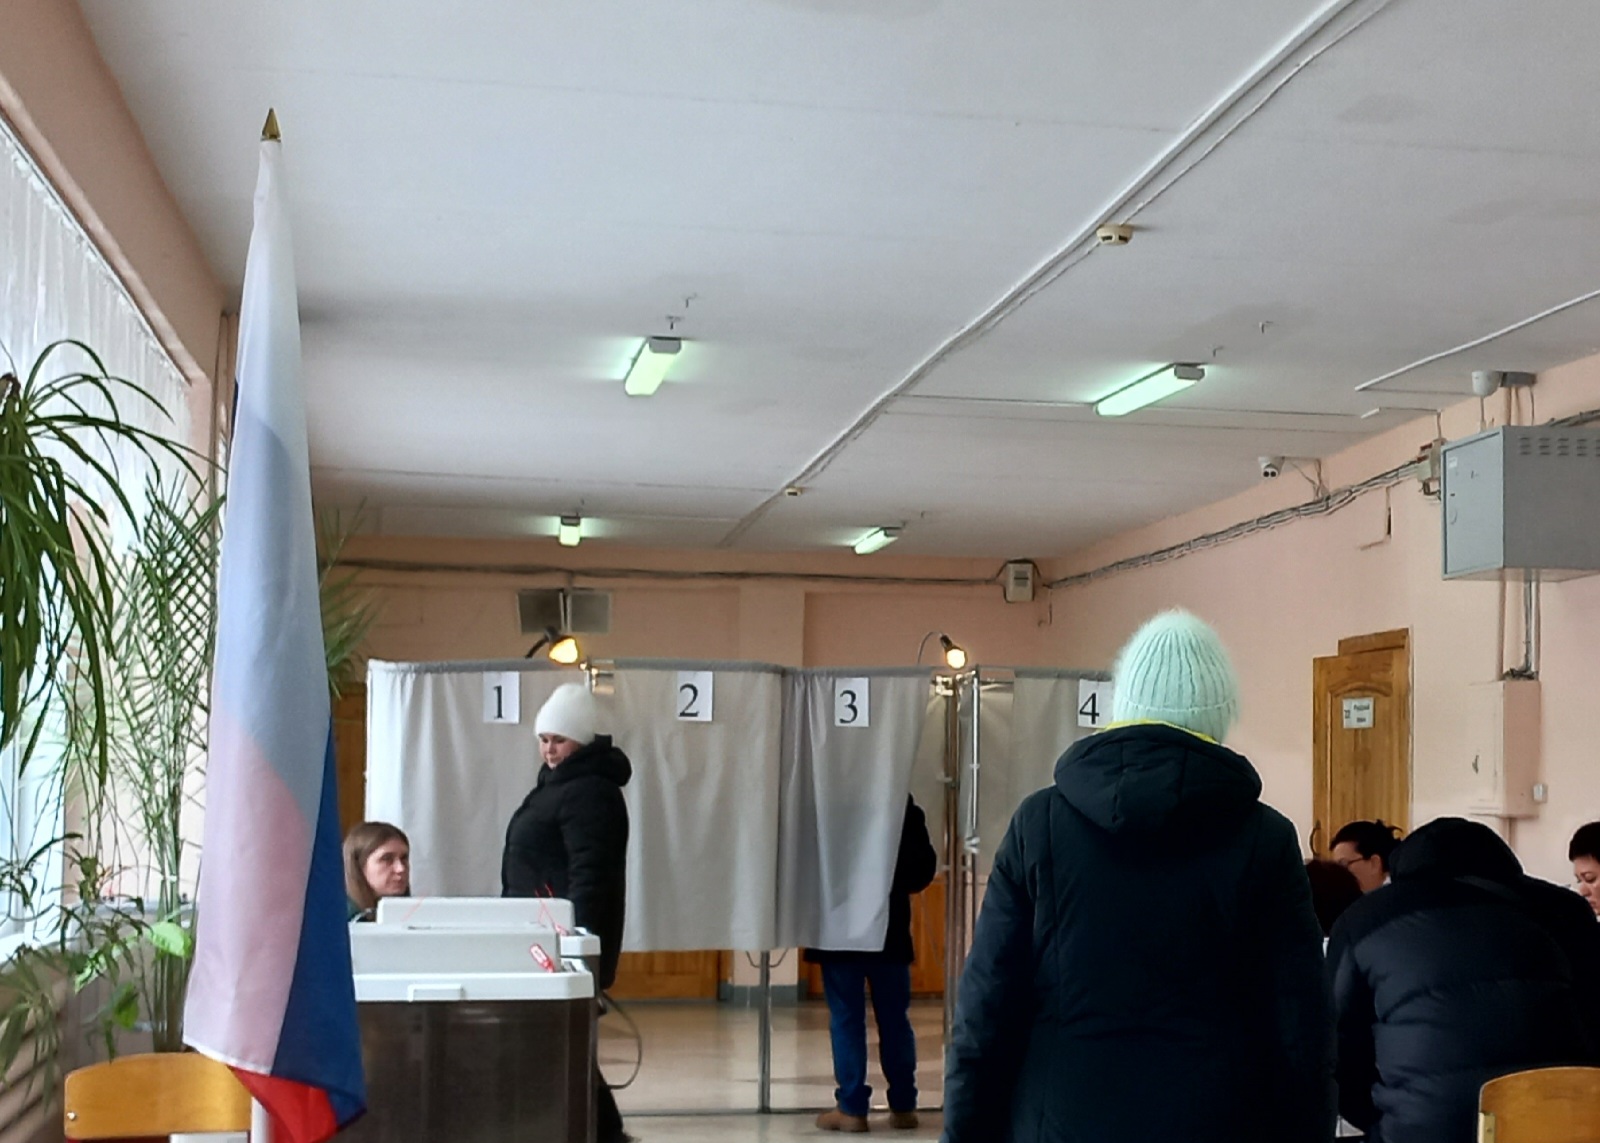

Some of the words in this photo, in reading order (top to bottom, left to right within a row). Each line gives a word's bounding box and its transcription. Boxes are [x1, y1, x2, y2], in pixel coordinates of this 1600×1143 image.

[493, 685, 504, 719] 1
[679, 684, 698, 717] 2
[839, 690, 858, 723] 3
[1079, 692, 1099, 725] 4
